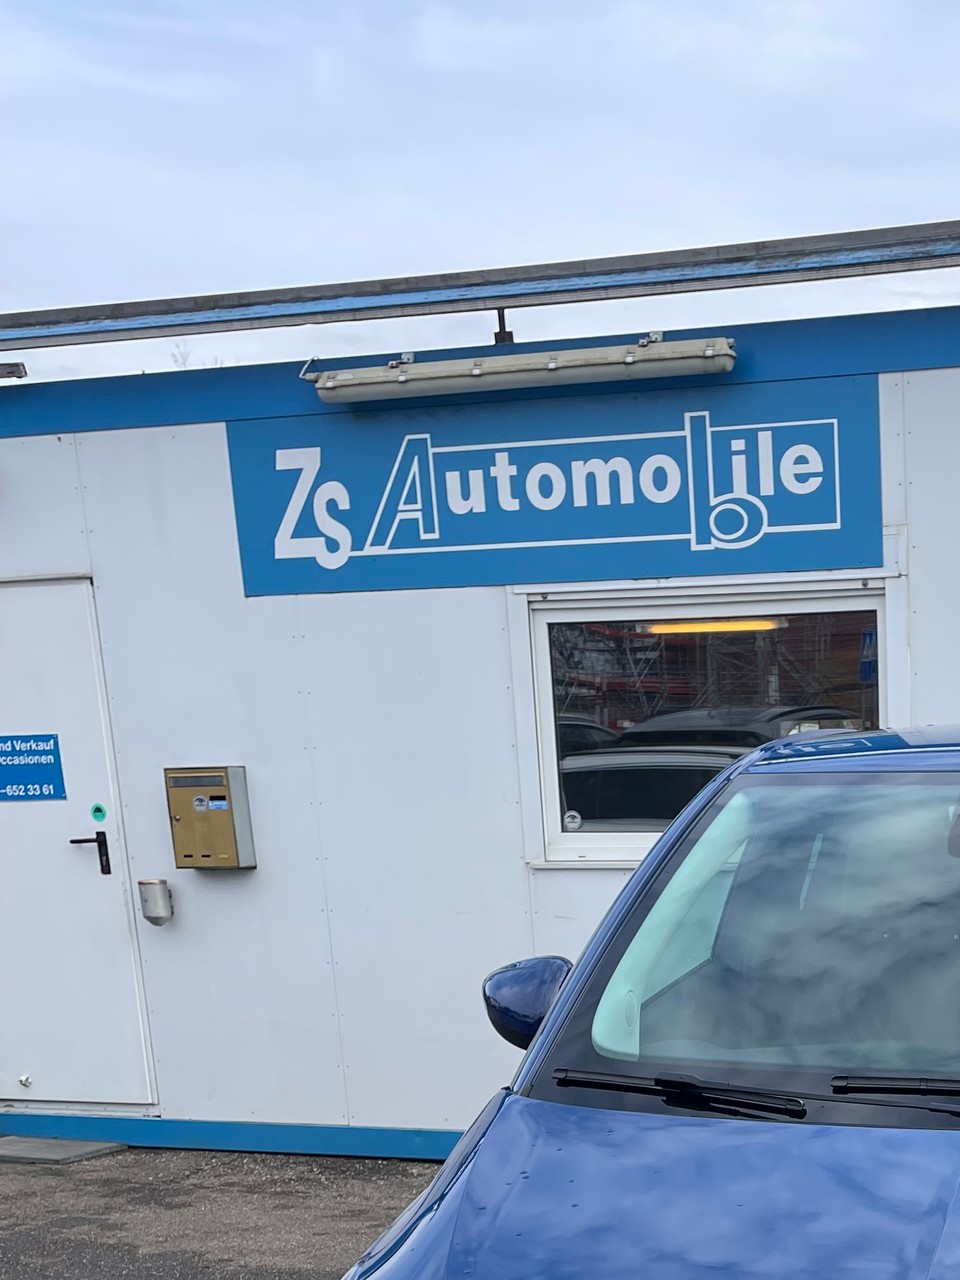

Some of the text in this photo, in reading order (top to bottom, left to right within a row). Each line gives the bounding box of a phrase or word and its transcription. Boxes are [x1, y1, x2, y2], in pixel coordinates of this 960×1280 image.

[364, 411, 824, 553] Automobile
[13, 739, 54, 751] Verkauf
[0, 753, 54, 765] ccasionen
[27, 784, 40, 796] 33
[42, 784, 54, 795] 61
